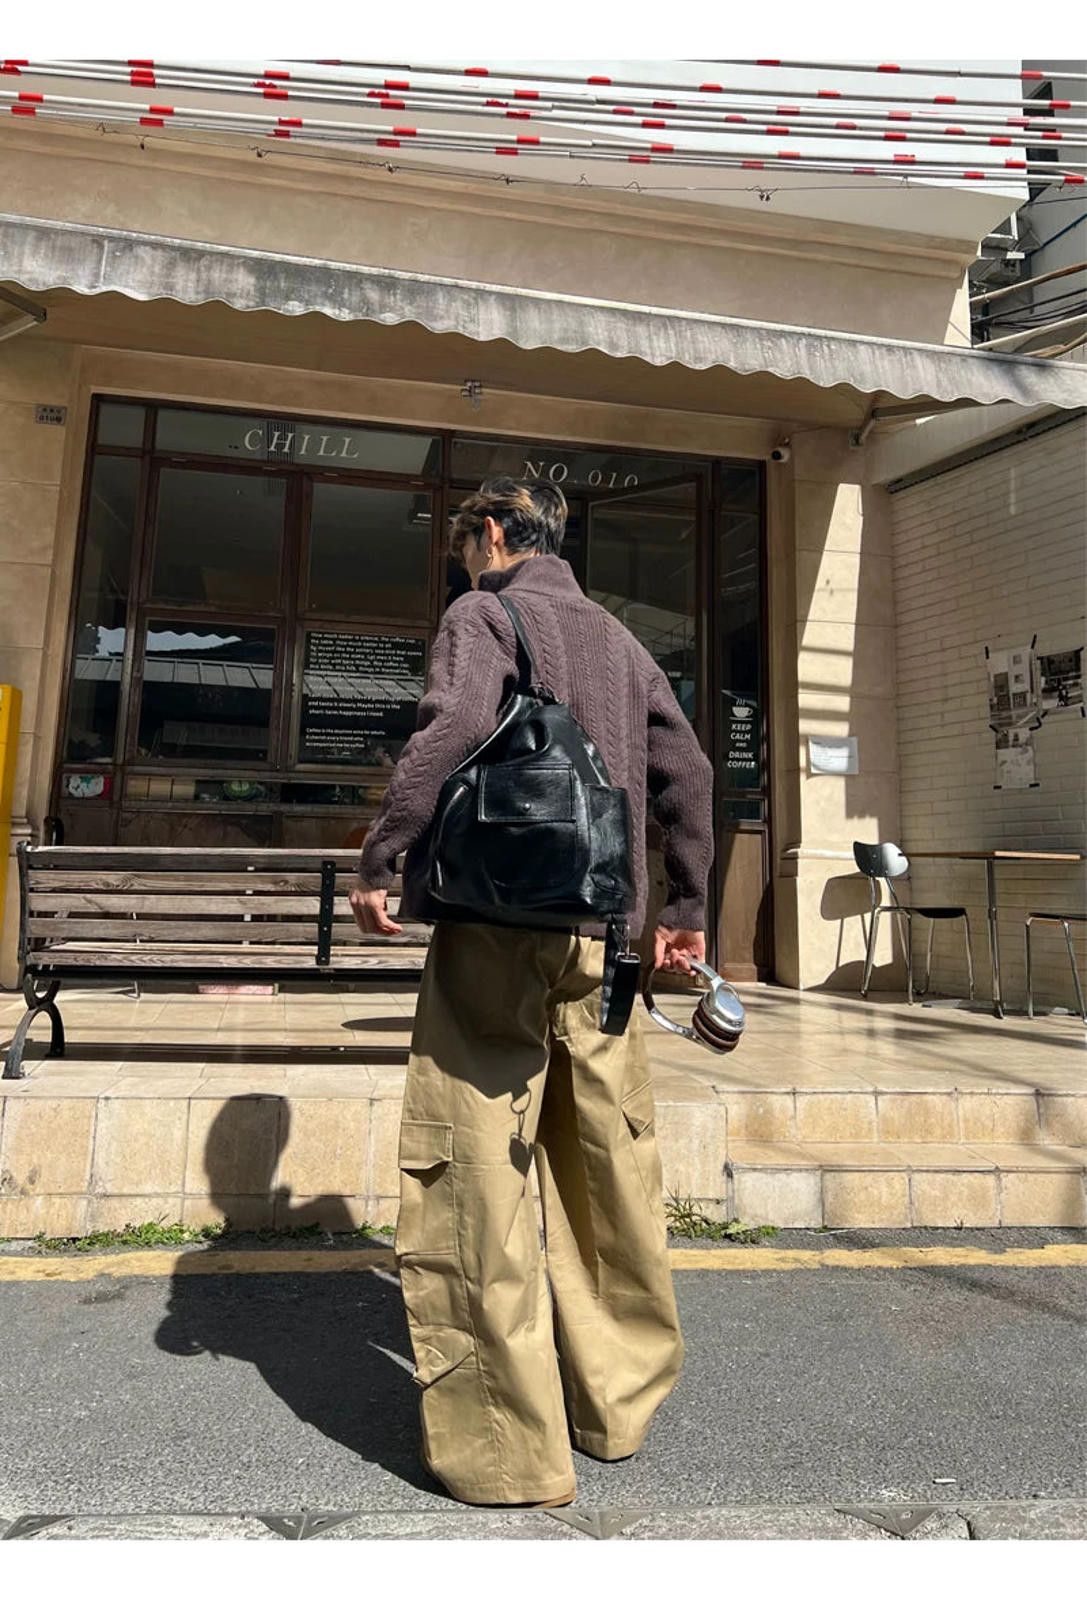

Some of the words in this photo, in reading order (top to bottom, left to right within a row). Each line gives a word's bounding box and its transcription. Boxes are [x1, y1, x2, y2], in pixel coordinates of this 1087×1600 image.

[244, 428, 360, 458] CHILL
[731, 723, 752, 731] KEEP
[730, 732, 751, 740] CALM
[727, 760, 756, 768] COFFEE
